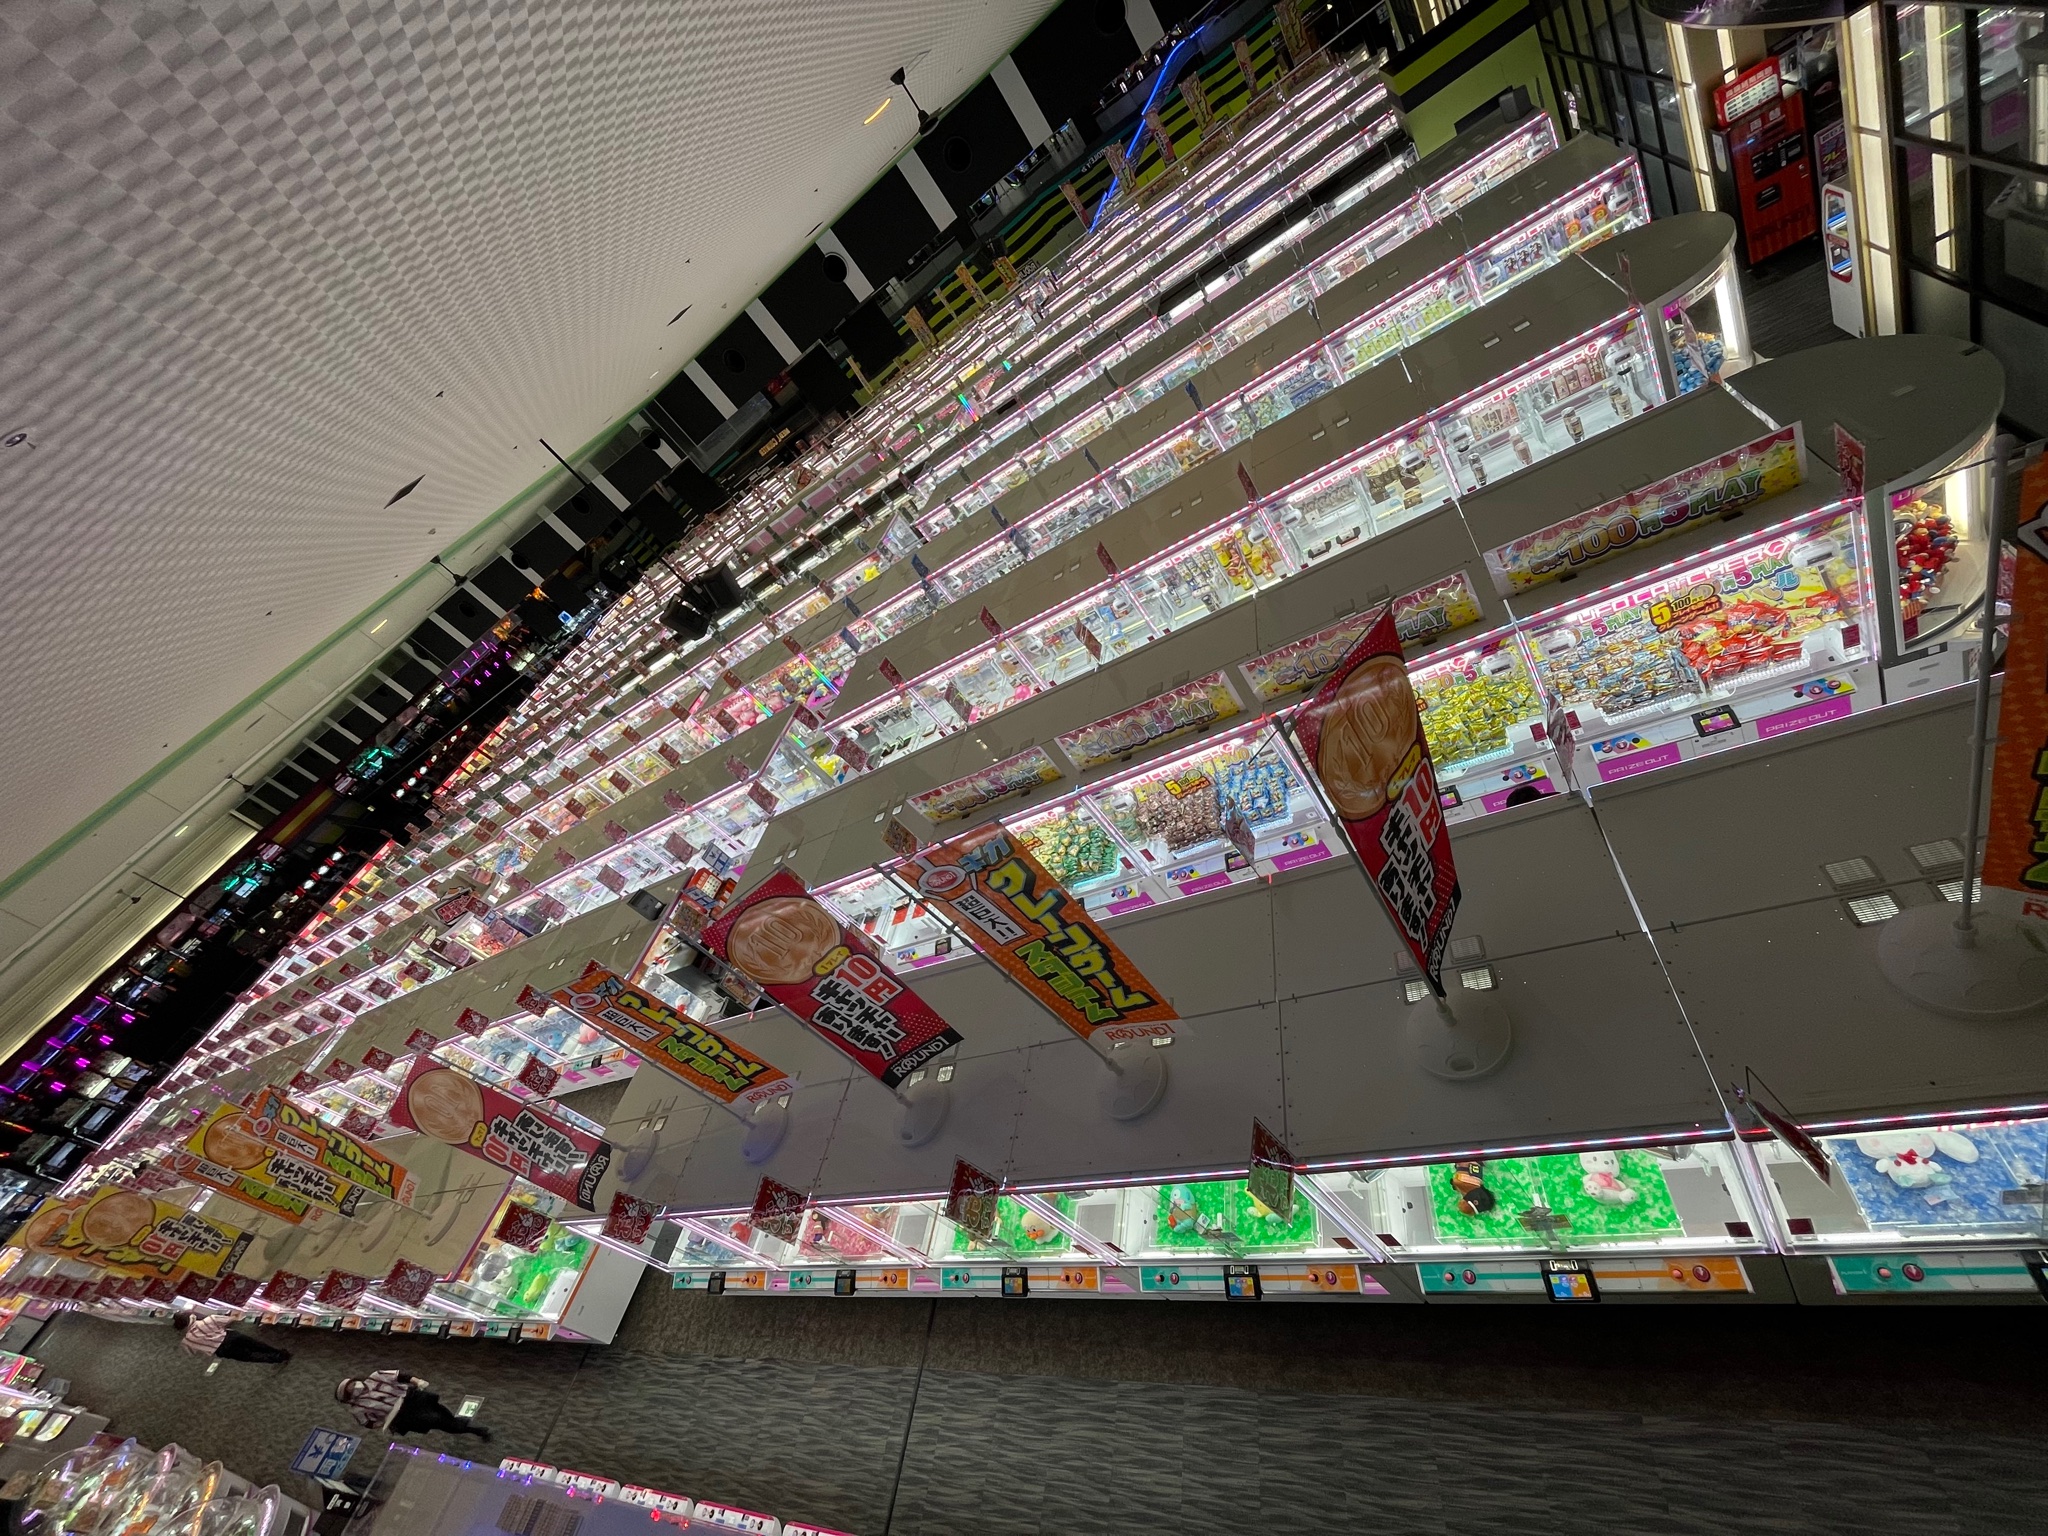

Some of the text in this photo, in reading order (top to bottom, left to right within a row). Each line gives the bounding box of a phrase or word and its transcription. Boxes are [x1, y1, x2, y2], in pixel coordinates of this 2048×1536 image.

[1632, 548, 1765, 602] CATCHER
[957, 836, 1013, 874] ギガ
[986, 858, 1157, 1011] クレーンゲーム
[816, 979, 903, 1041] キャッチャー
[1013, 939, 1123, 1023] スタジアム
[616, 991, 770, 1079] クレーンゲーム
[892, 1036, 950, 1077] ROUND1
